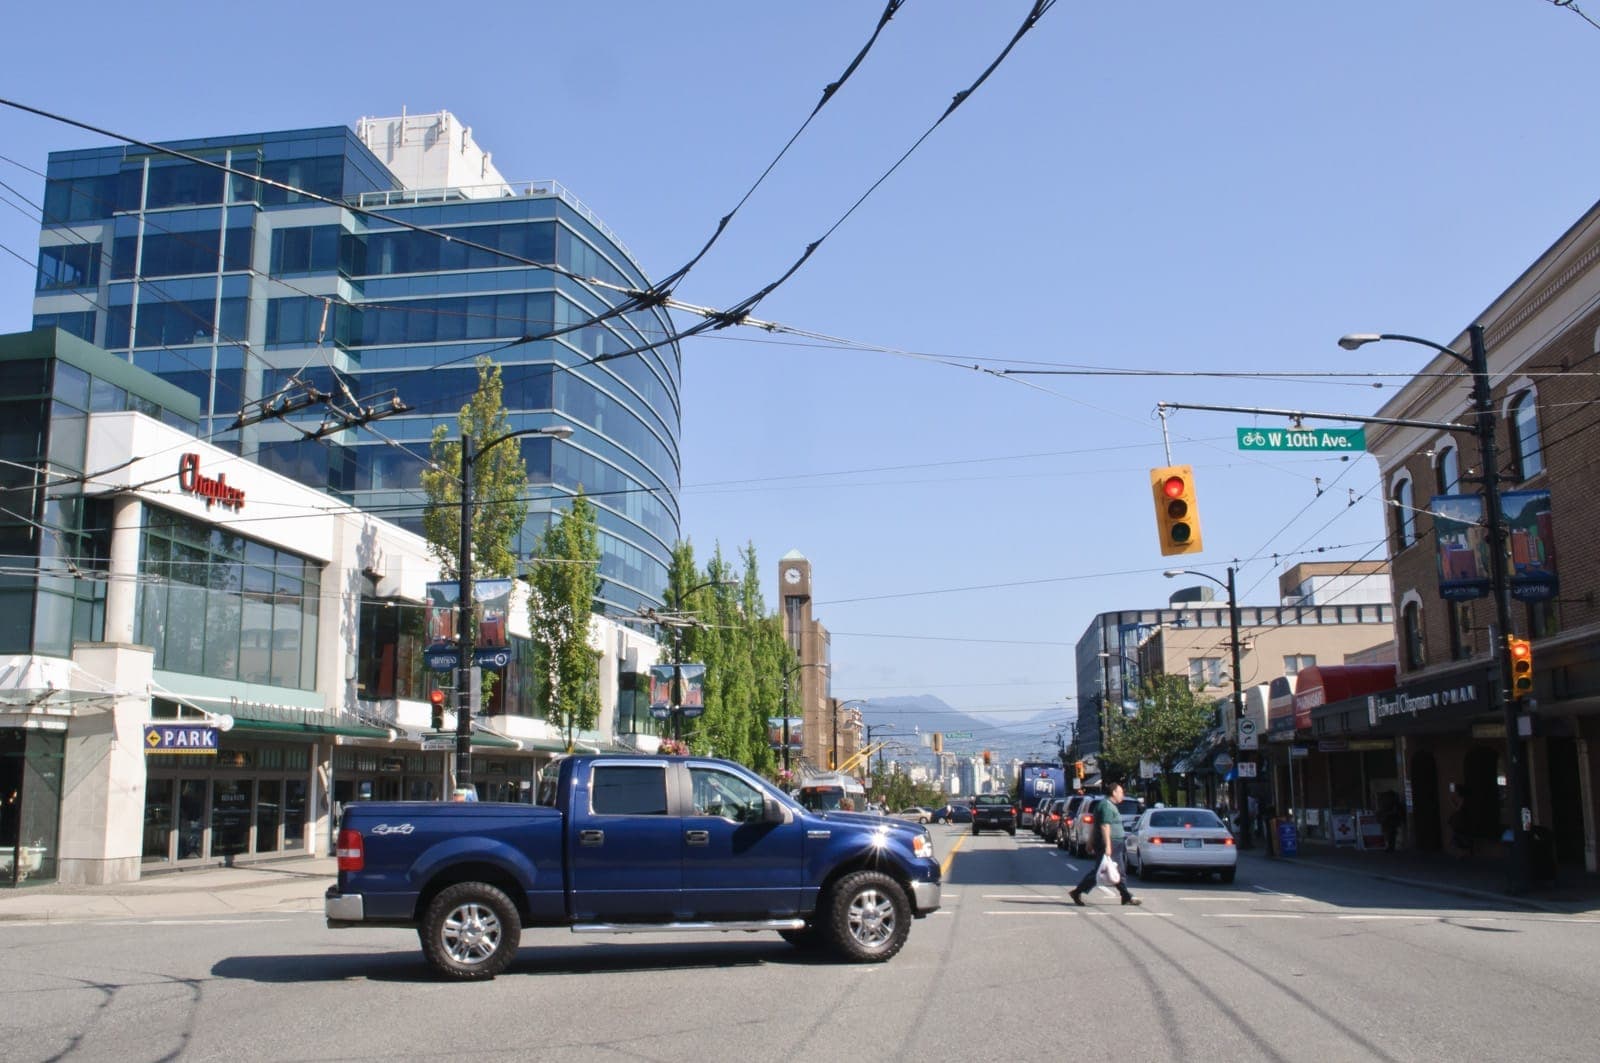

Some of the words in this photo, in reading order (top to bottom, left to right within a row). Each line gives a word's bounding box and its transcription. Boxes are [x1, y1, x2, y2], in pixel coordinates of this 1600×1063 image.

[1268, 433, 1281, 447] W
[1285, 433, 1318, 447] 10th
[1321, 433, 1352, 447] Ave.
[179, 453, 245, 508] Chapters
[164, 730, 213, 746] PARK
[1036, 780, 1053, 793] BFI
